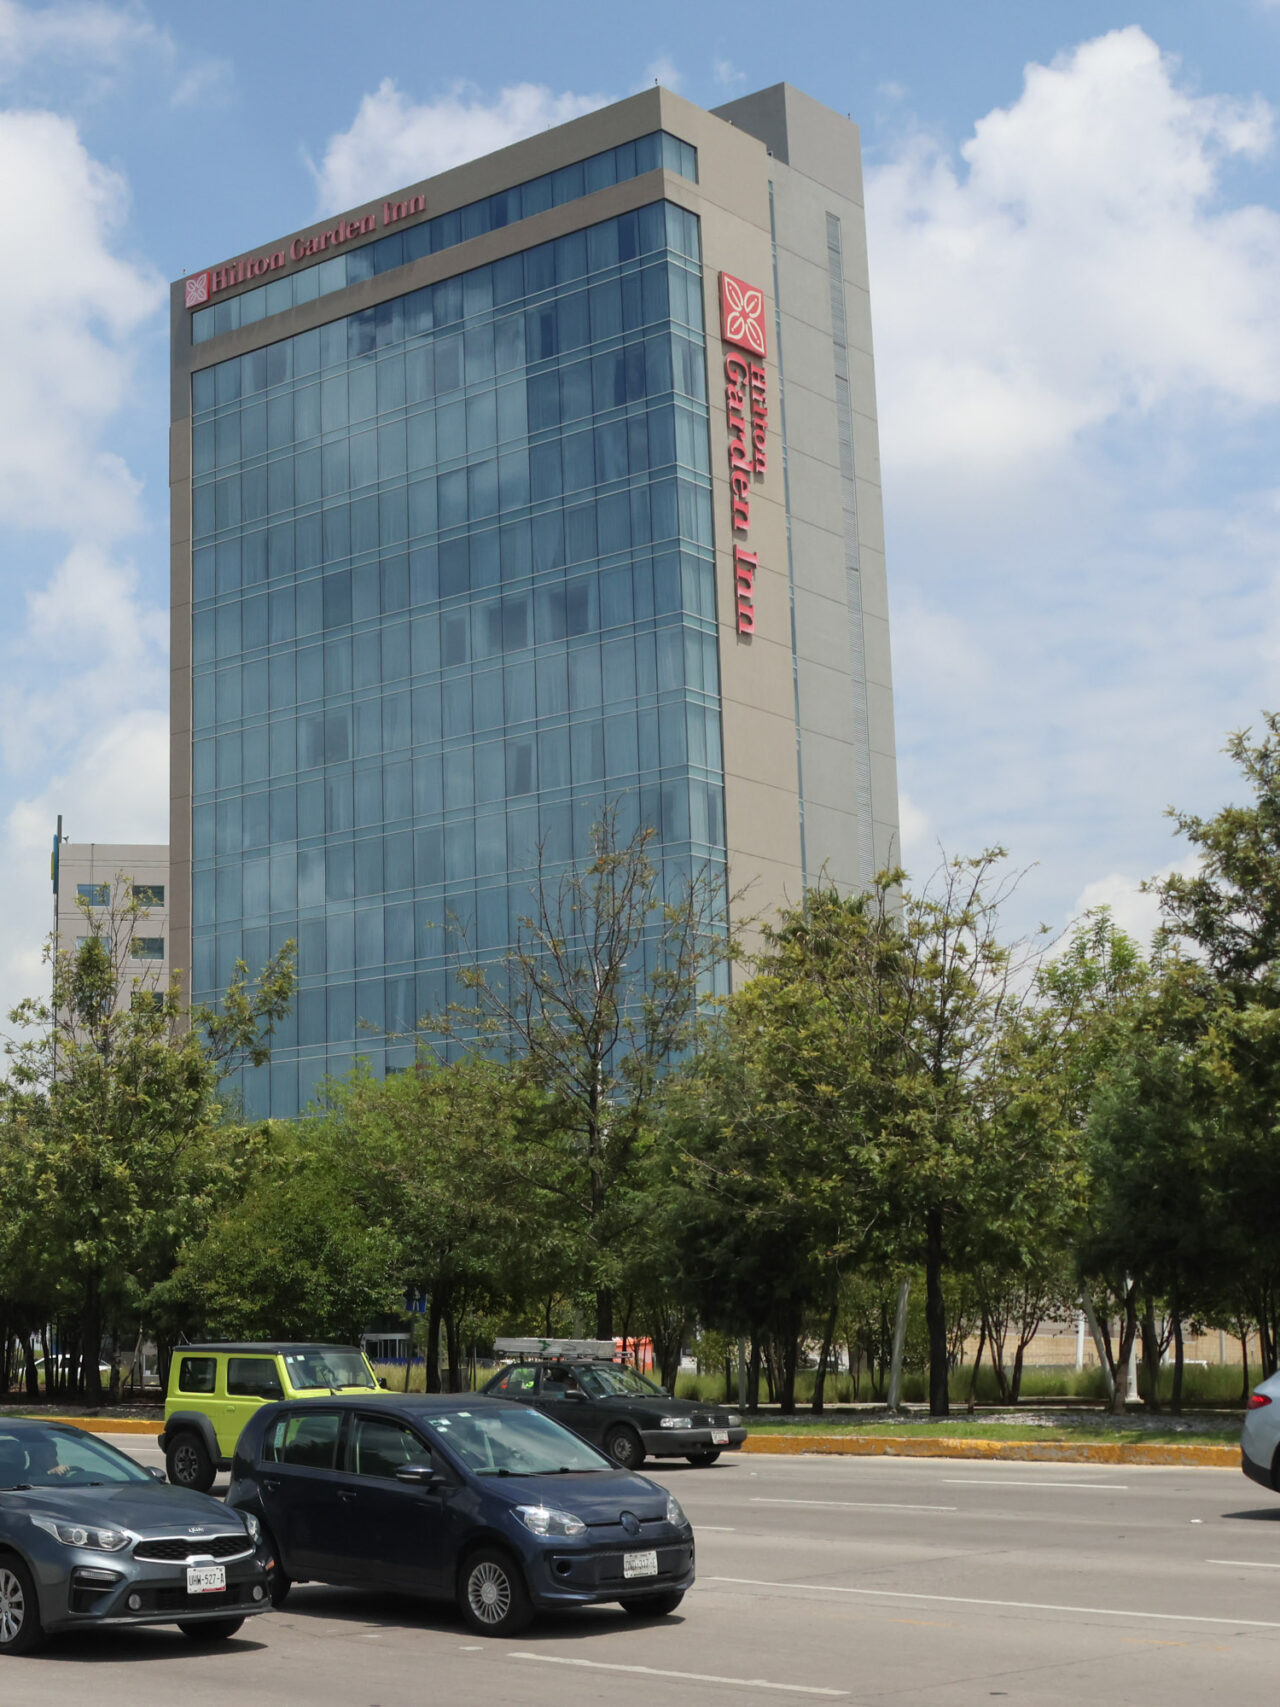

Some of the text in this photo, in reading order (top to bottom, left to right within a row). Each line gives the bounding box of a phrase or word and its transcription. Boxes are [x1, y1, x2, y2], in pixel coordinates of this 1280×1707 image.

[211, 193, 426, 293] Hilton Garden Inn
[750, 361, 768, 473] Hilton
[725, 352, 758, 634] Garden Inn
